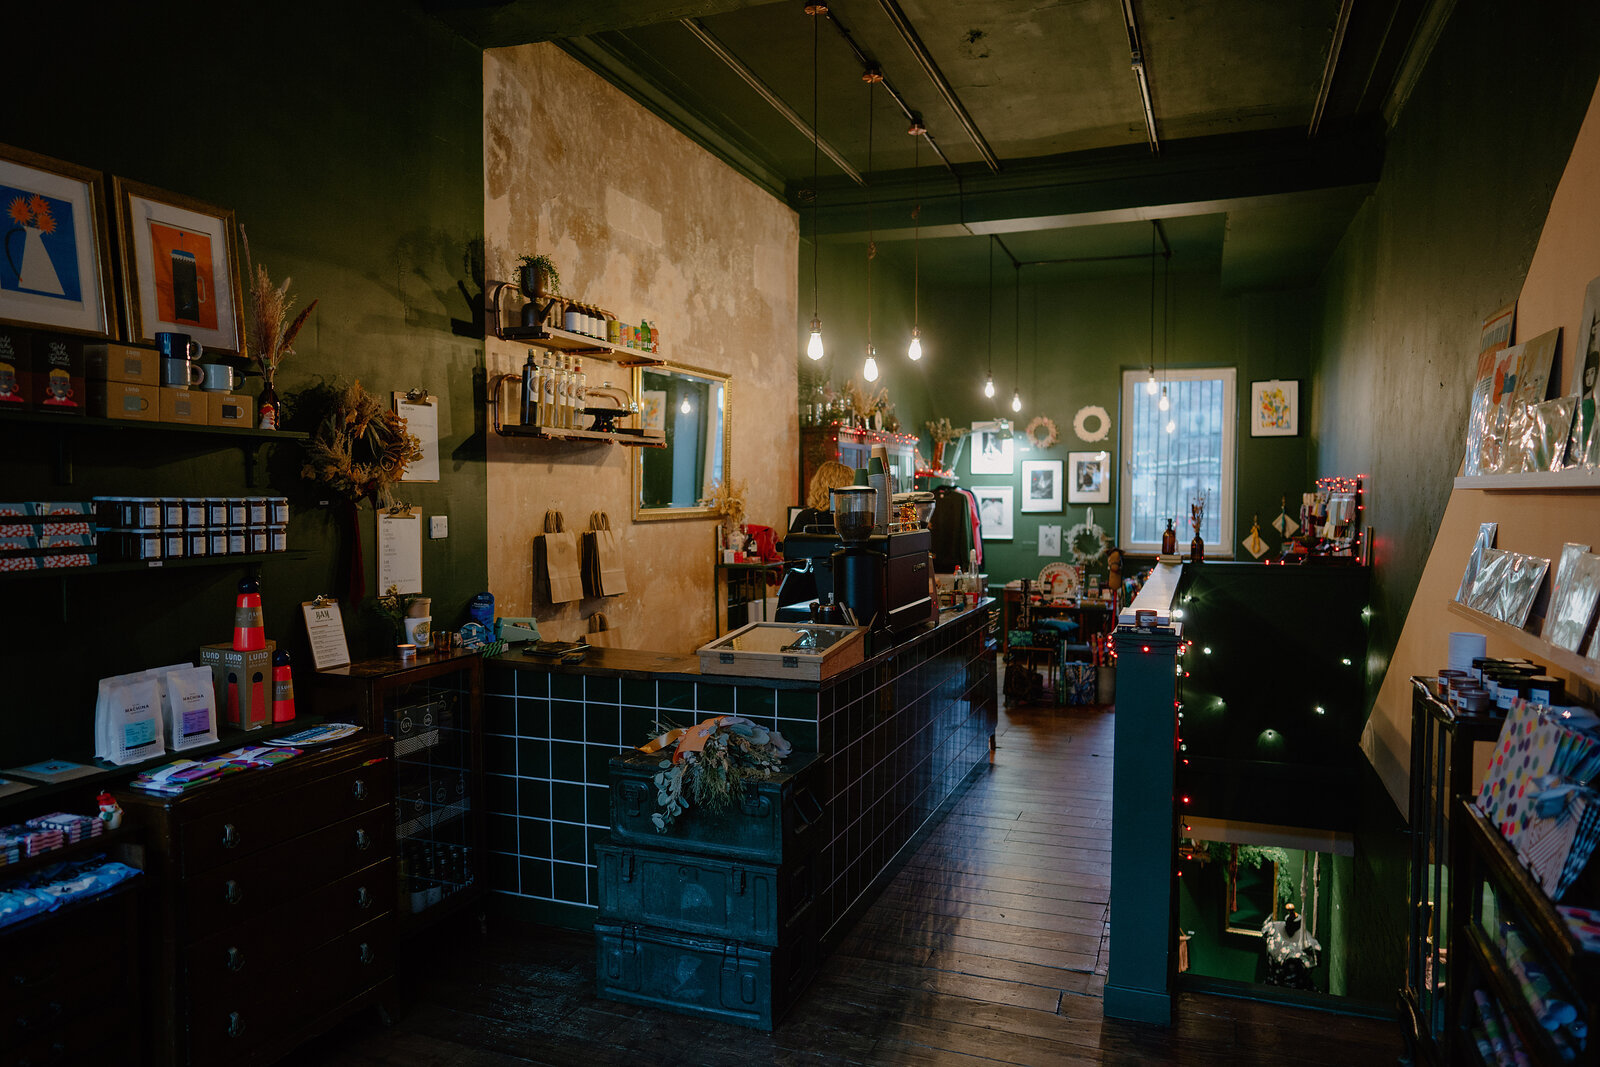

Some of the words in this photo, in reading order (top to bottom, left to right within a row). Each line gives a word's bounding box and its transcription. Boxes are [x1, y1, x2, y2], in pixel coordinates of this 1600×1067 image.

[202, 651, 220, 660] LUND
[225, 653, 243, 662] LUND
[248, 651, 269, 661] LUND
[125, 704, 149, 713] MACHINA
